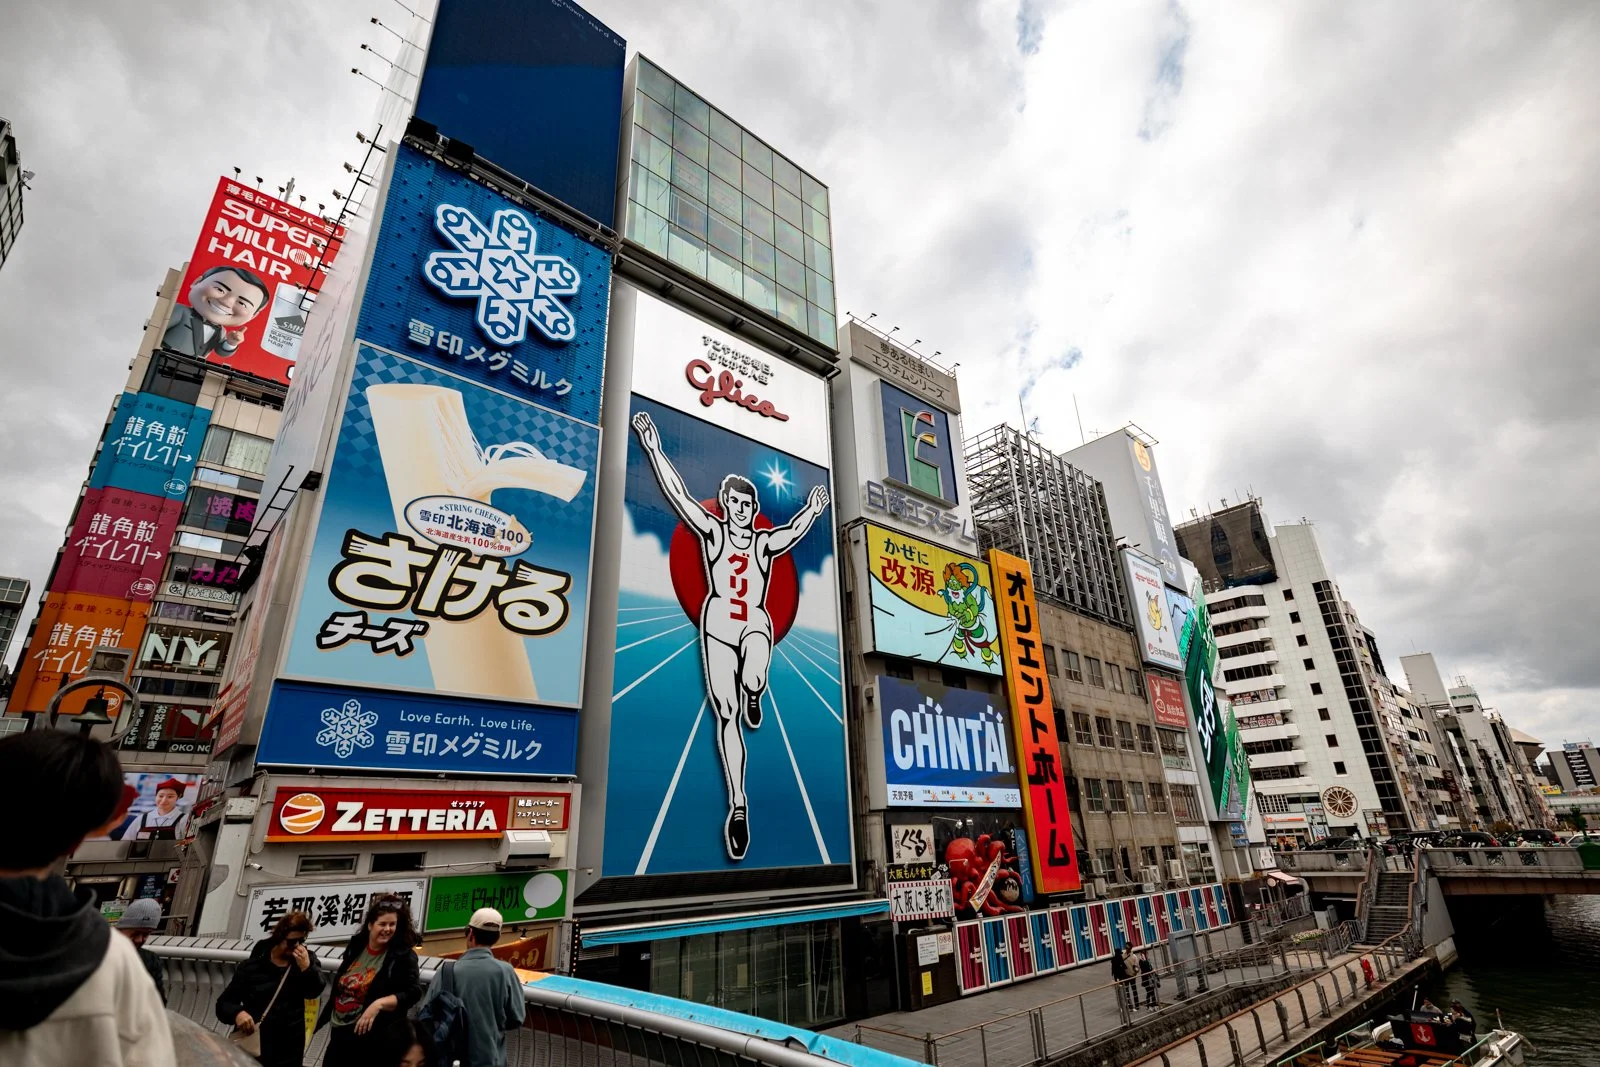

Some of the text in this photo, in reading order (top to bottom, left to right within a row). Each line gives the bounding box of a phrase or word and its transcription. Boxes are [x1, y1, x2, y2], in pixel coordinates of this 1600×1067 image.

[221, 199, 328, 253] SUPER
[208, 237, 292, 281] HAIR
[214, 217, 332, 275] MILLION
[409, 318, 573, 396] 雪印メグミルク
[686, 359, 789, 422] Glico
[124, 416, 189, 446] 龍角散
[111, 437, 192, 467] ダイレクト
[88, 513, 158, 543] 龍角散
[444, 503, 503, 526] STRING CHEESE
[74, 536, 162, 566] ダイレクト
[883, 537, 929, 566] かぜに
[328, 529, 573, 635] さける
[727, 552, 750, 622] グリコ
[880, 556, 937, 596] 改源
[316, 610, 430, 657] チーズ
[33, 649, 91, 674] ダイレ
[146, 704, 168, 750] お好み焼き
[400, 710, 536, 731] Love Earth. Love Life.
[1006, 570, 1070, 868] オリエントホーム
[385, 730, 542, 761] 雪印メグミルク
[890, 697, 1010, 774] CHINTAI
[331, 801, 498, 832] ZETTERIA
[450, 800, 486, 808] ゼッテリア
[518, 799, 560, 807] 絶品バーガー
[893, 886, 945, 914] 大阪に乾杯
